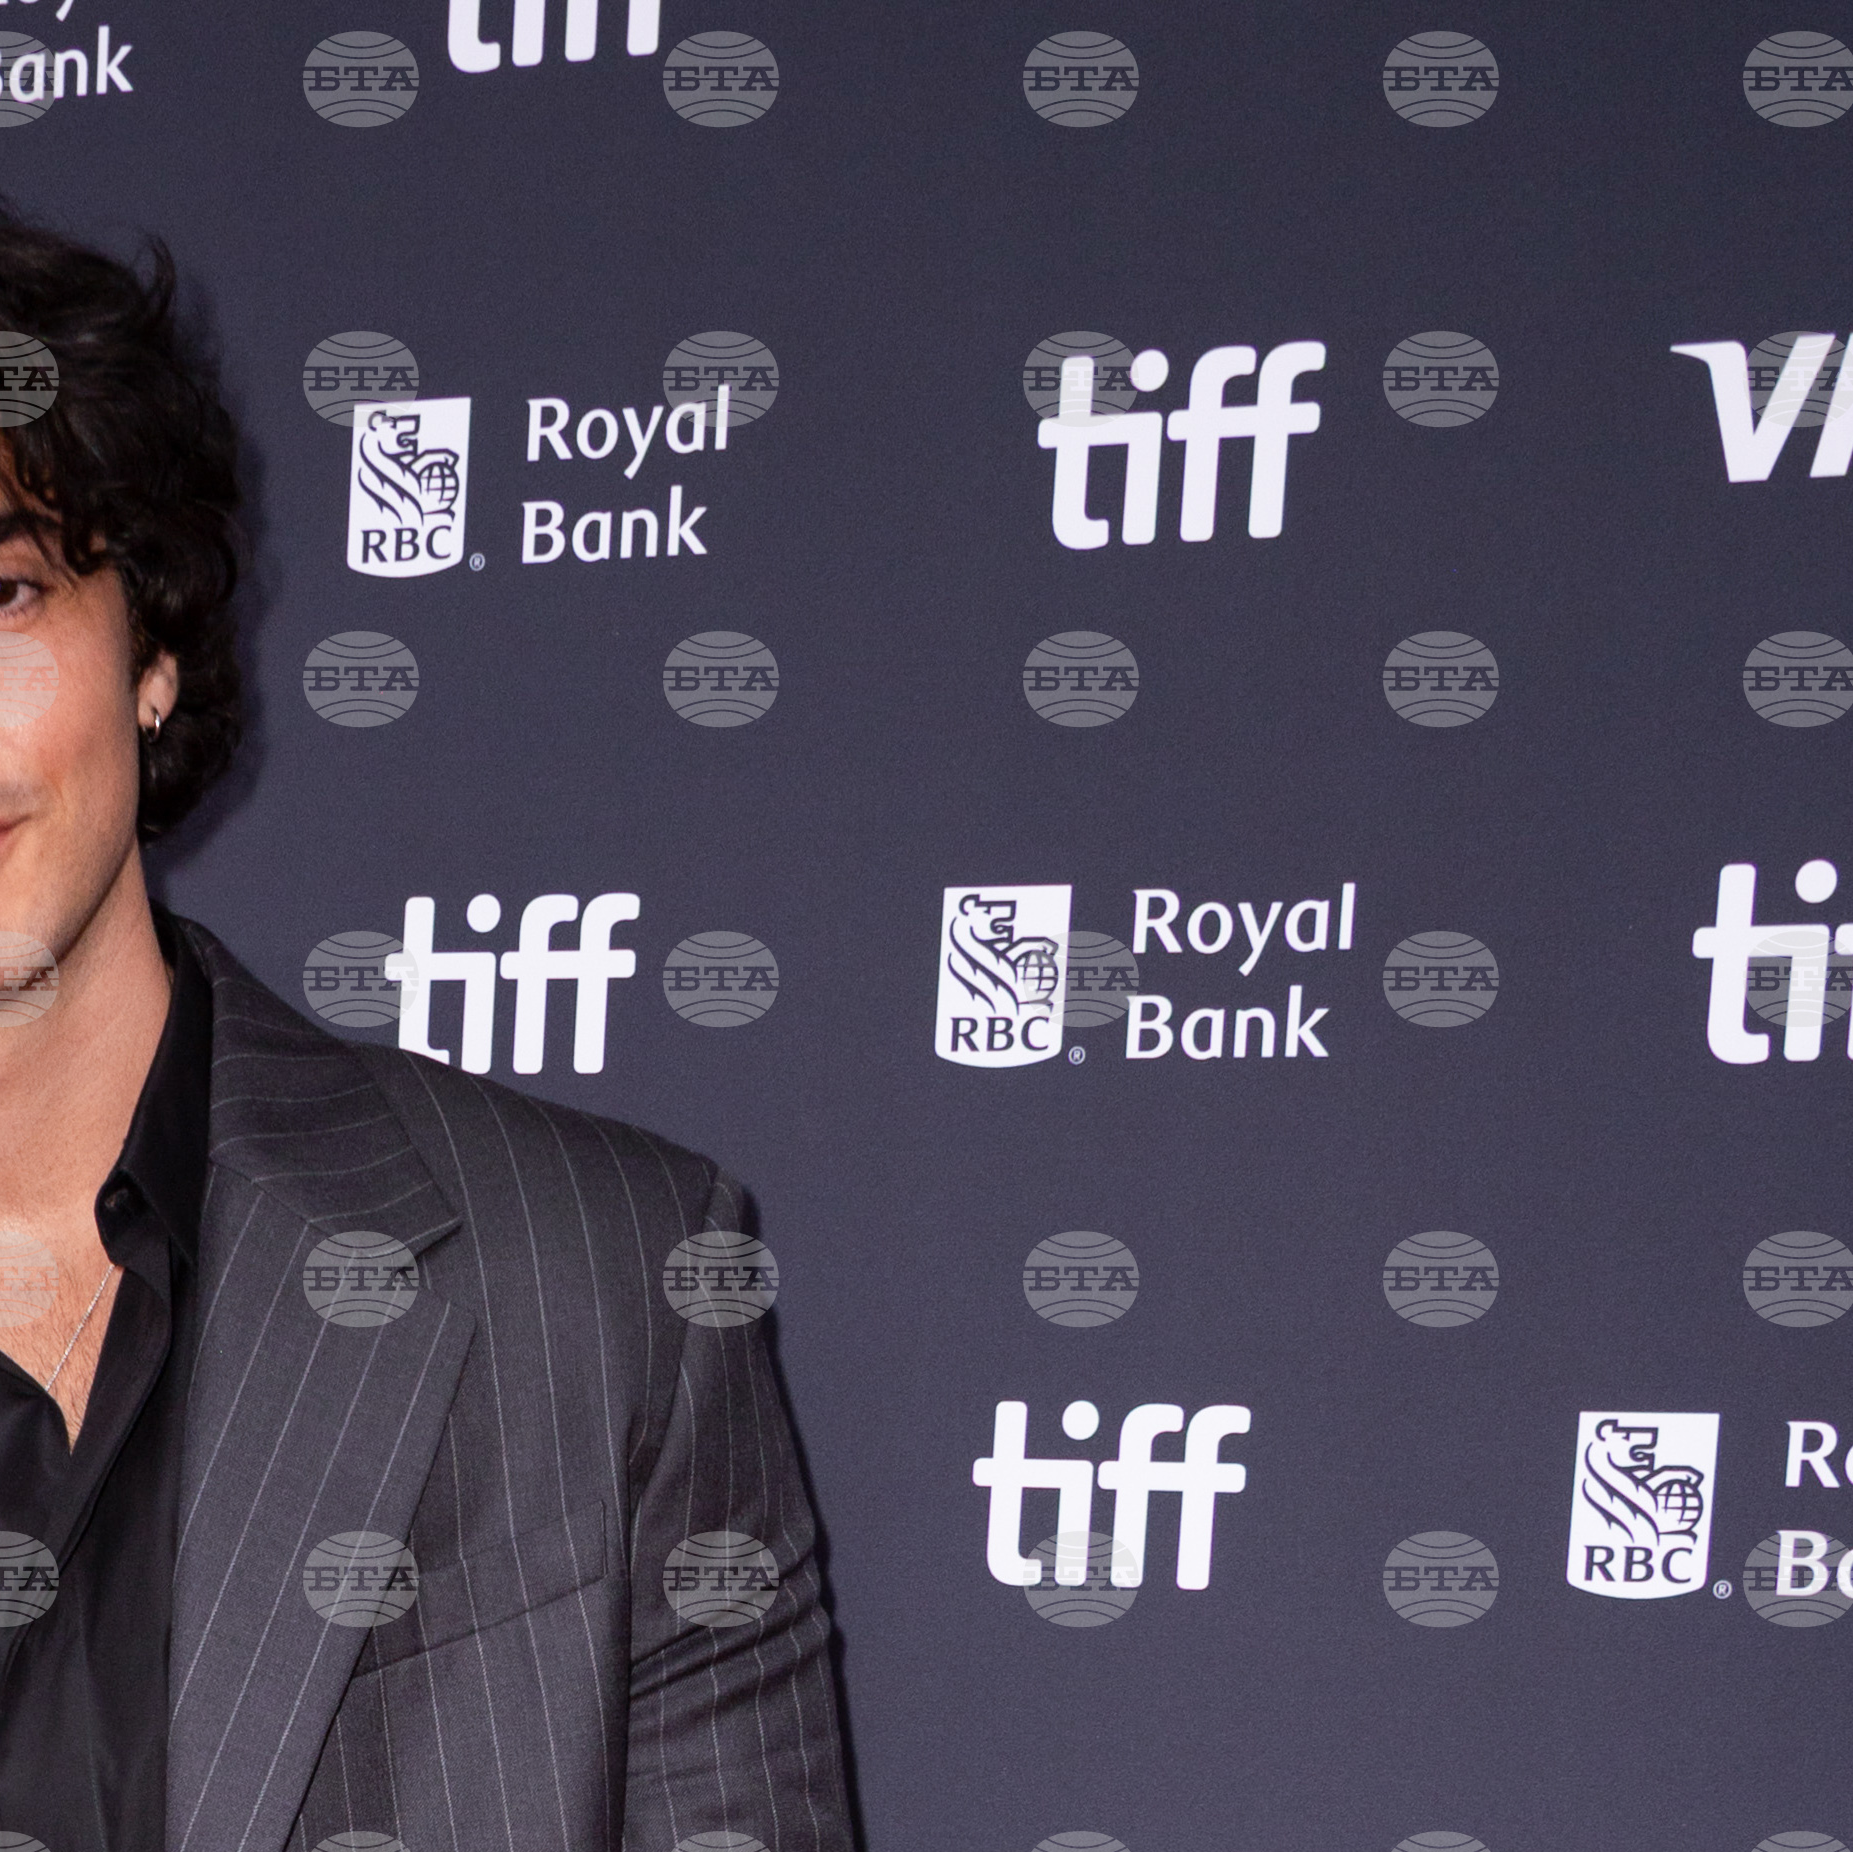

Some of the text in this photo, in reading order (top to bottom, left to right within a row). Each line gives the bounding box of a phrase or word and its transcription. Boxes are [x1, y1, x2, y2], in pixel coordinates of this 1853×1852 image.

[528, 384, 729, 478] Royal
[1038, 342, 1325, 549] tiff
[362, 526, 451, 563] RBC
[523, 486, 706, 563] Bank
[1133, 883, 1355, 976] Royal
[1693, 861, 1853, 1064] ti
[384, 893, 640, 1074] tiff
[1126, 985, 1328, 1059] Bank
[951, 1016, 1049, 1051] RBC
[973, 1401, 1251, 1589] tiff
[1585, 1546, 1692, 1583] RBC
